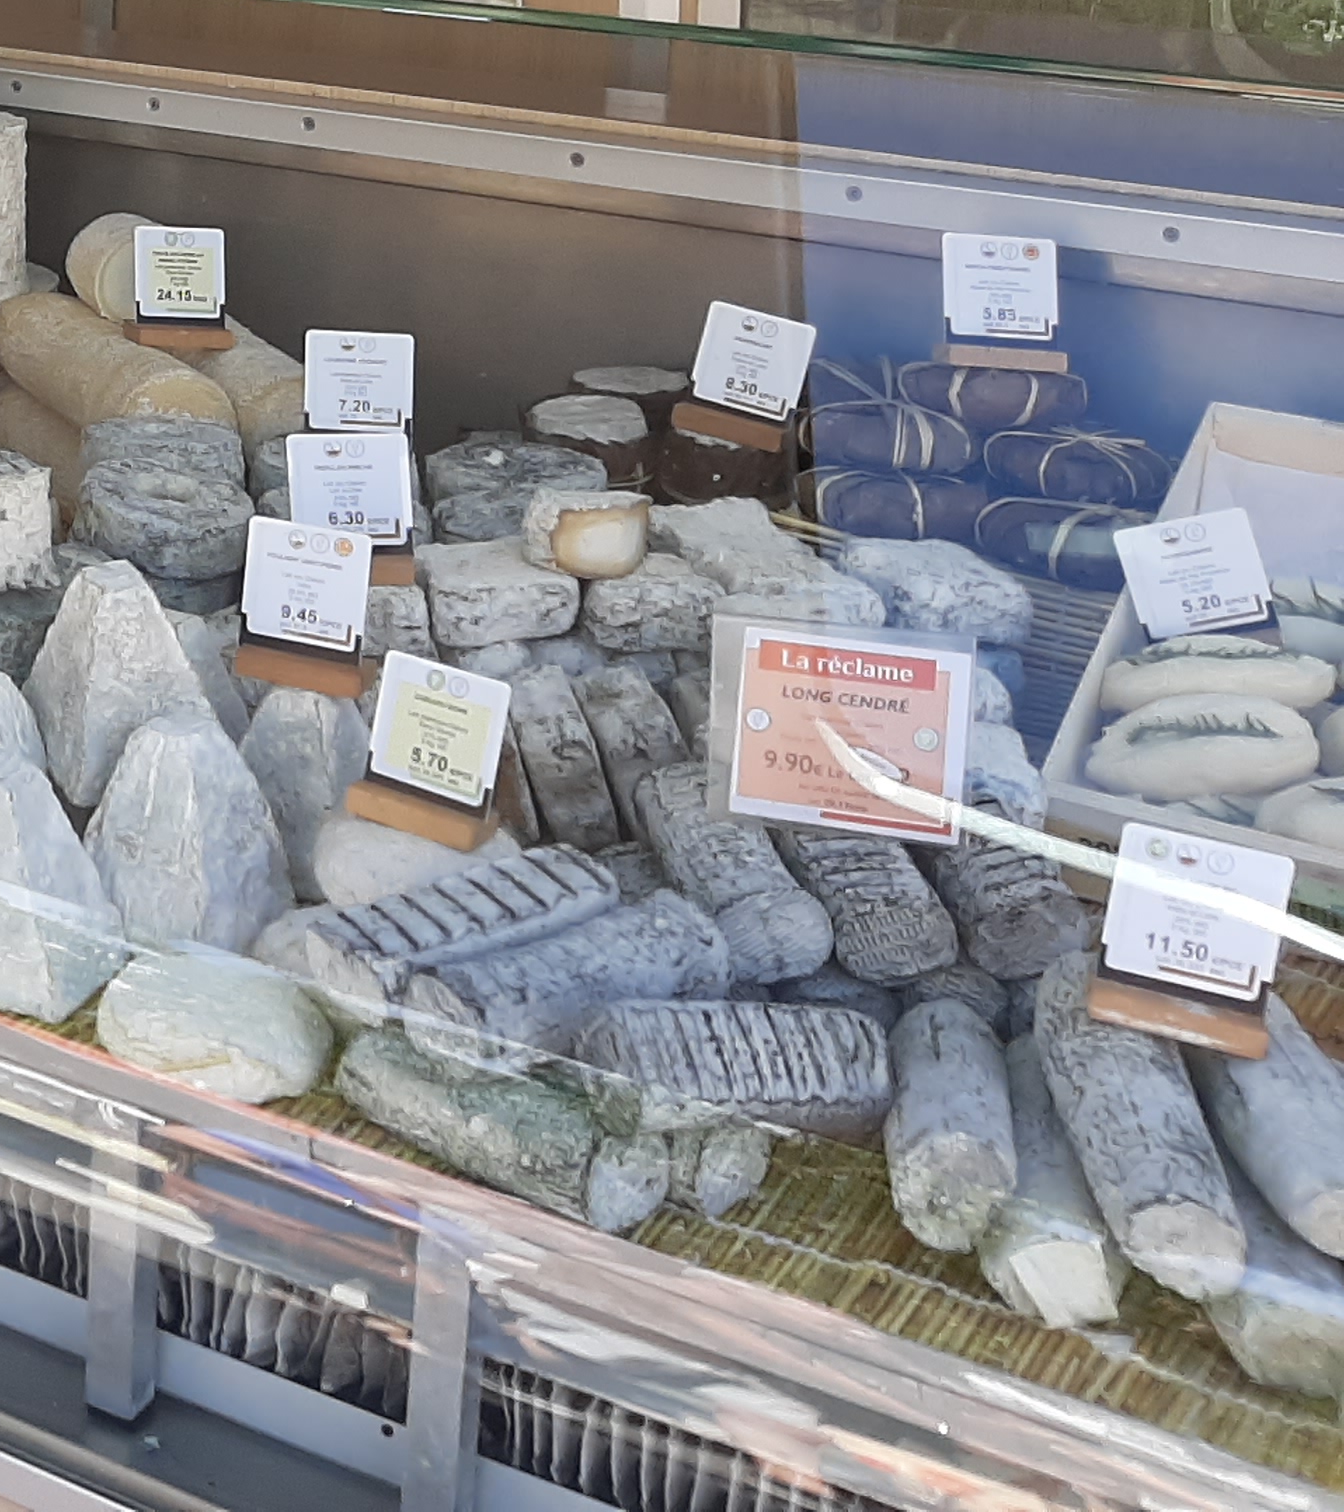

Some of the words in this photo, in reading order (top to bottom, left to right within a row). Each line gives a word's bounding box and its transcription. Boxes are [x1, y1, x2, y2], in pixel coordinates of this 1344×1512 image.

[338, 398, 371, 413] 7.20
[328, 510, 365, 526] 6.30
[1181, 594, 1222, 614] 5.20
[781, 648, 810, 672] La
[817, 656, 914, 683] réclame
[782, 684, 832, 704] LONG
[837, 692, 910, 714] CENDRÉ
[410, 746, 448, 773] 5.70
[1145, 932, 1209, 962] 11.50
